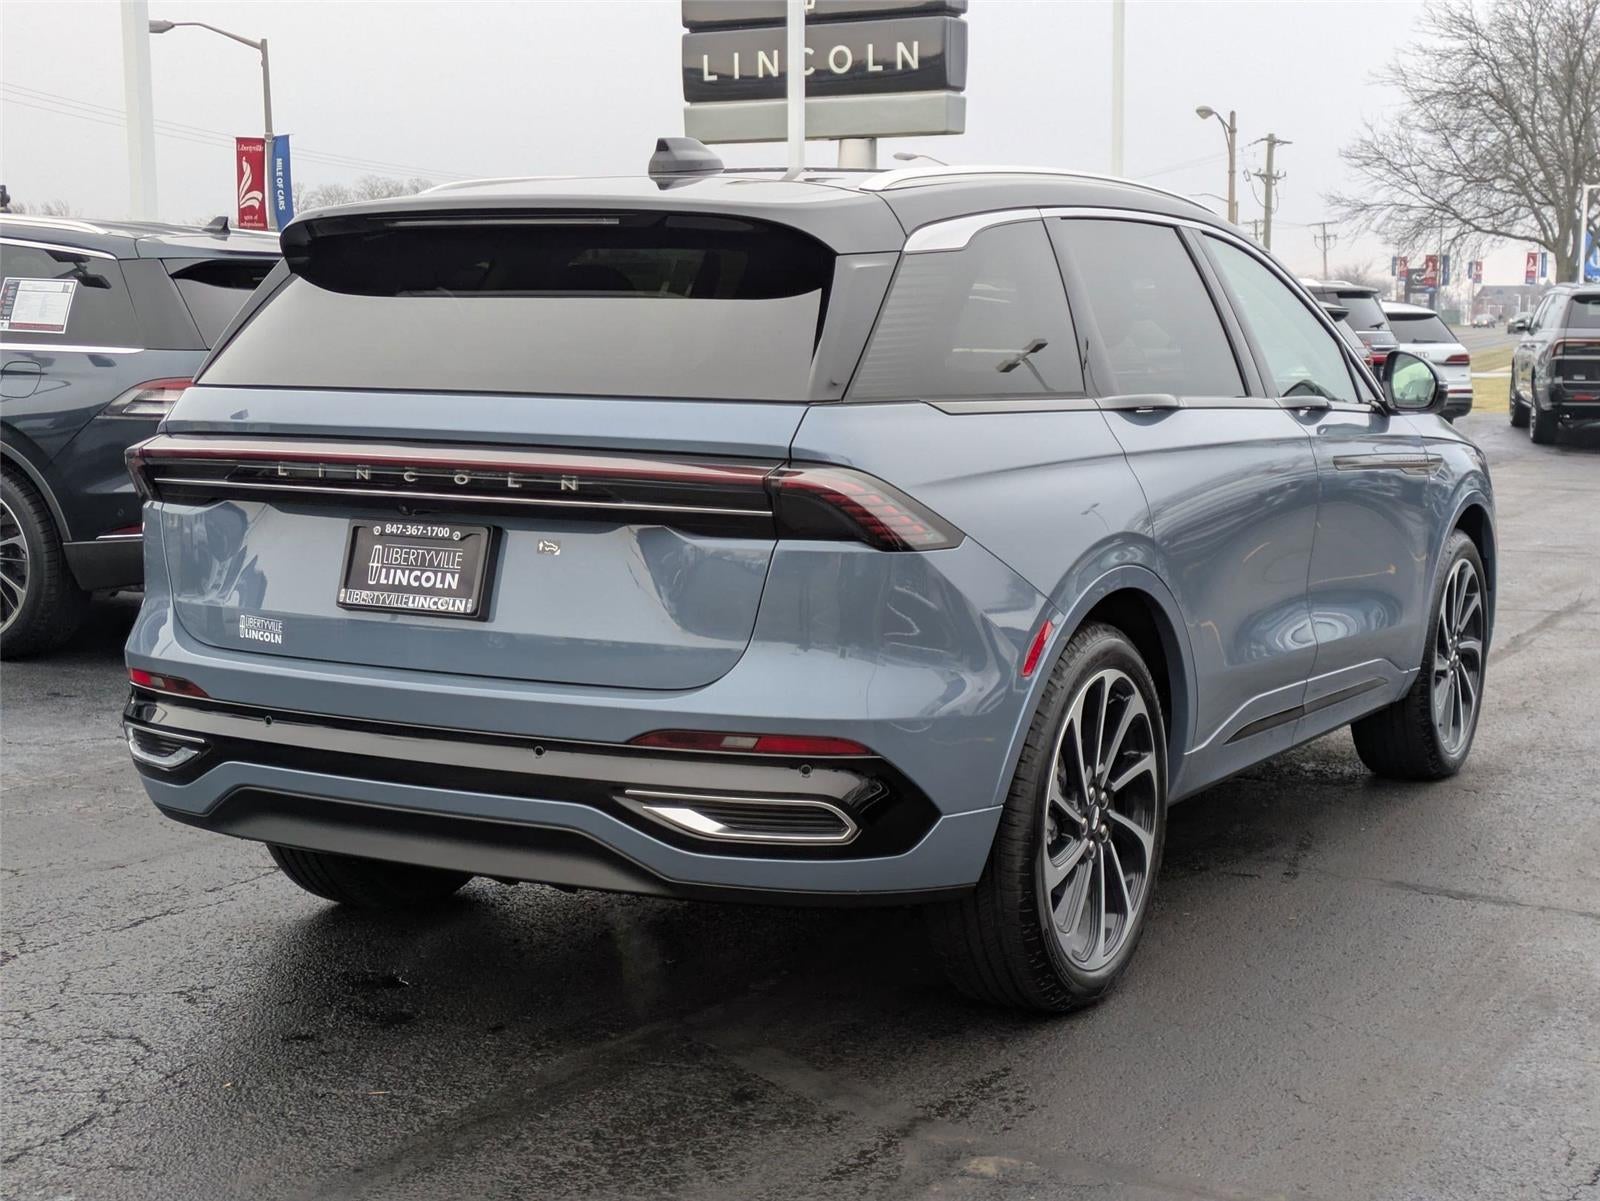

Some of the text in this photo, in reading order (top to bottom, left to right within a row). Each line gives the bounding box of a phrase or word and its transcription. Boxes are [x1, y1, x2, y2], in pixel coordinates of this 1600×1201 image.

[277, 177, 283, 189] OF
[277, 190, 285, 210] CARS
[277, 463, 579, 491] LINCOLN
[385, 523, 450, 537] 847-367-1700
[383, 547, 463, 569] LIBERTYVILLE
[380, 568, 459, 590] LINCOLN
[245, 616, 283, 633] LIBERTYVILLE
[245, 629, 282, 645] LINCOLN
